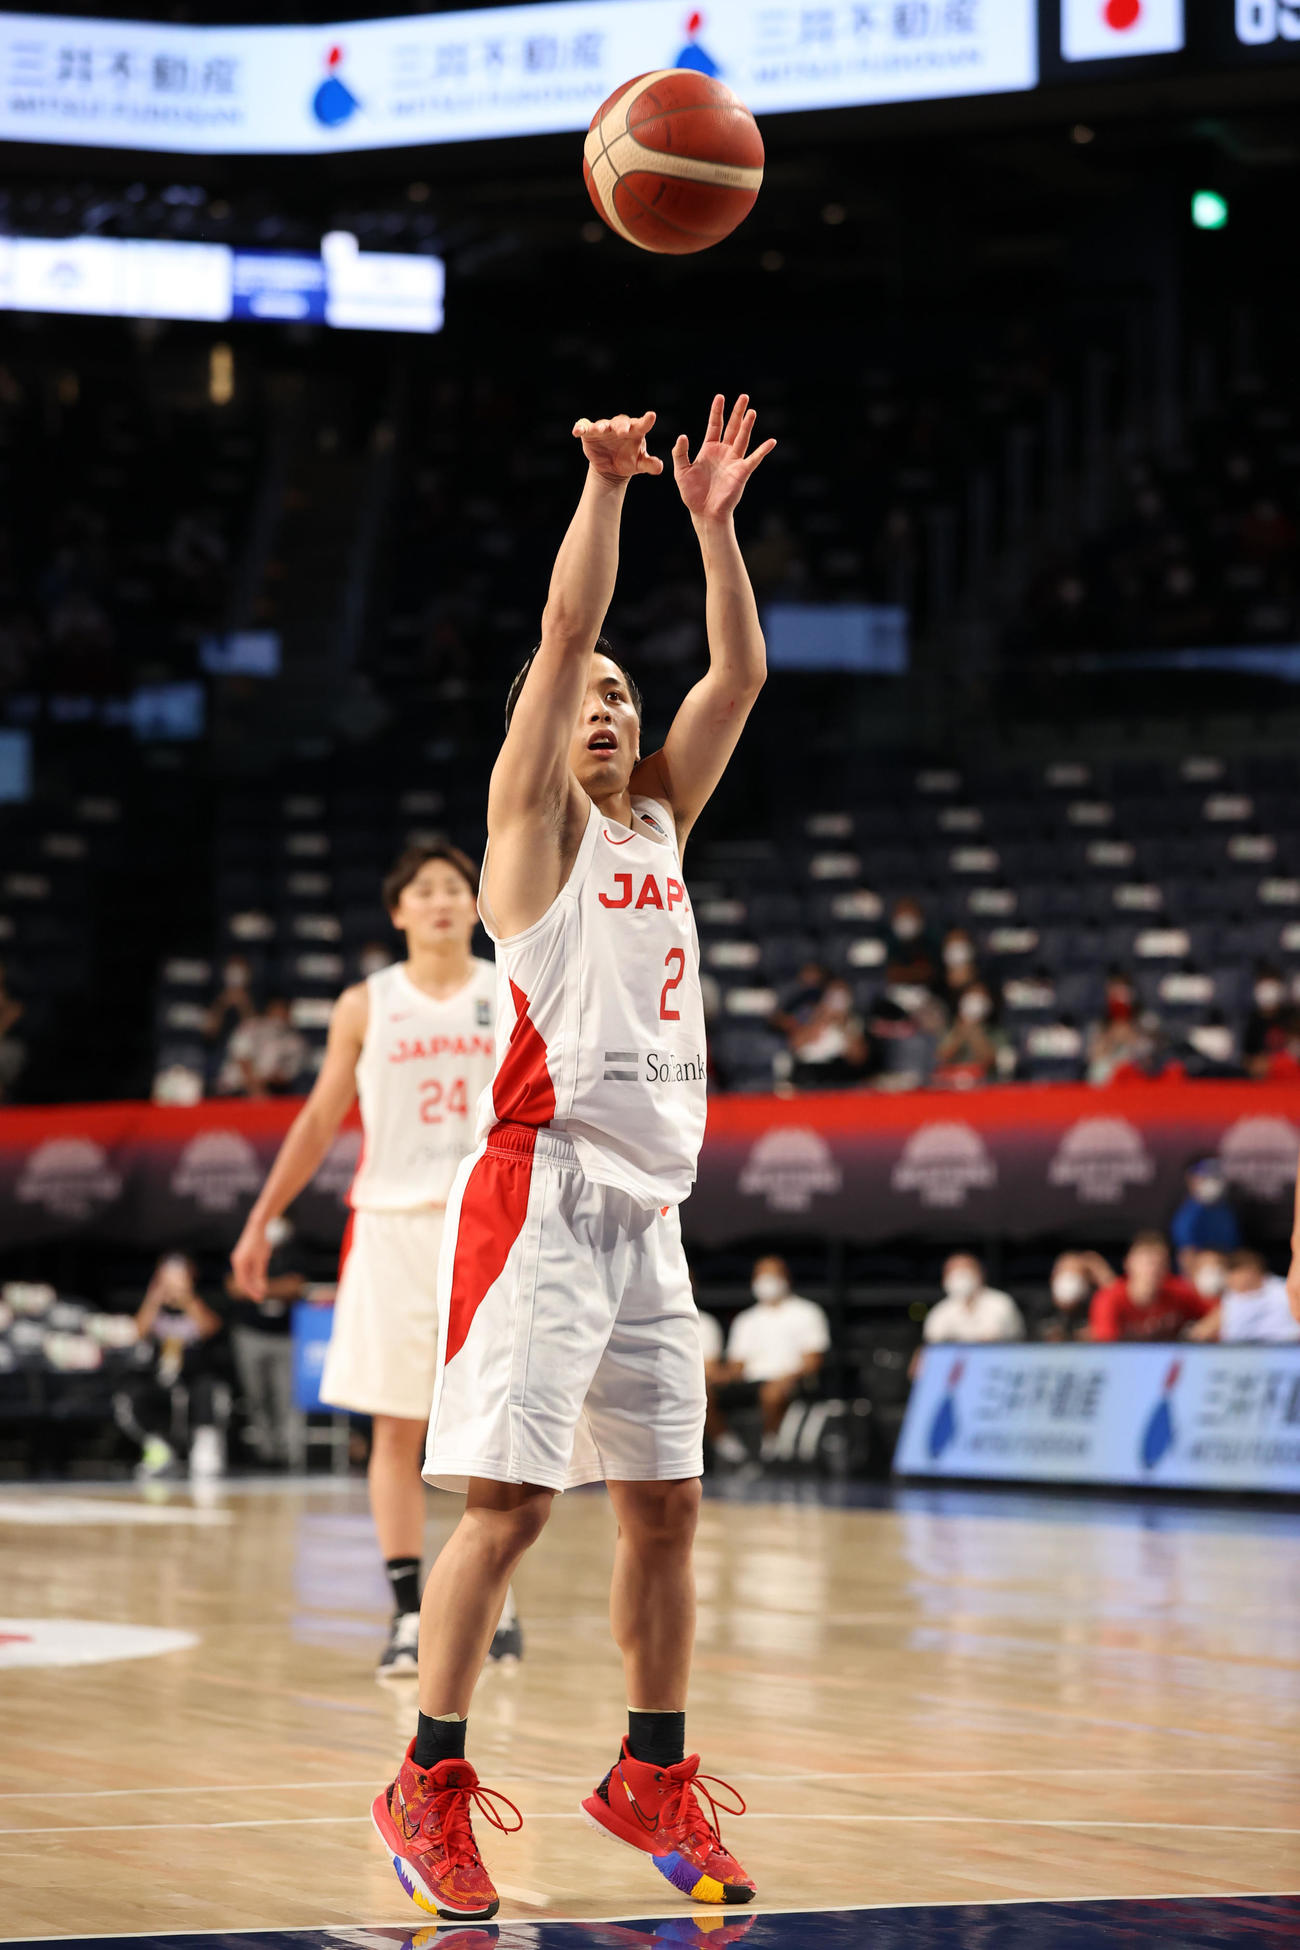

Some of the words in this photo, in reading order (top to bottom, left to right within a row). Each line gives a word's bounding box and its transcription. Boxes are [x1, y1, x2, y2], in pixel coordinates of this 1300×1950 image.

[598, 873, 689, 912] JAP
[659, 947, 685, 1021] 2
[388, 1034, 494, 1063] JAPAN
[418, 1078, 469, 1123] 24
